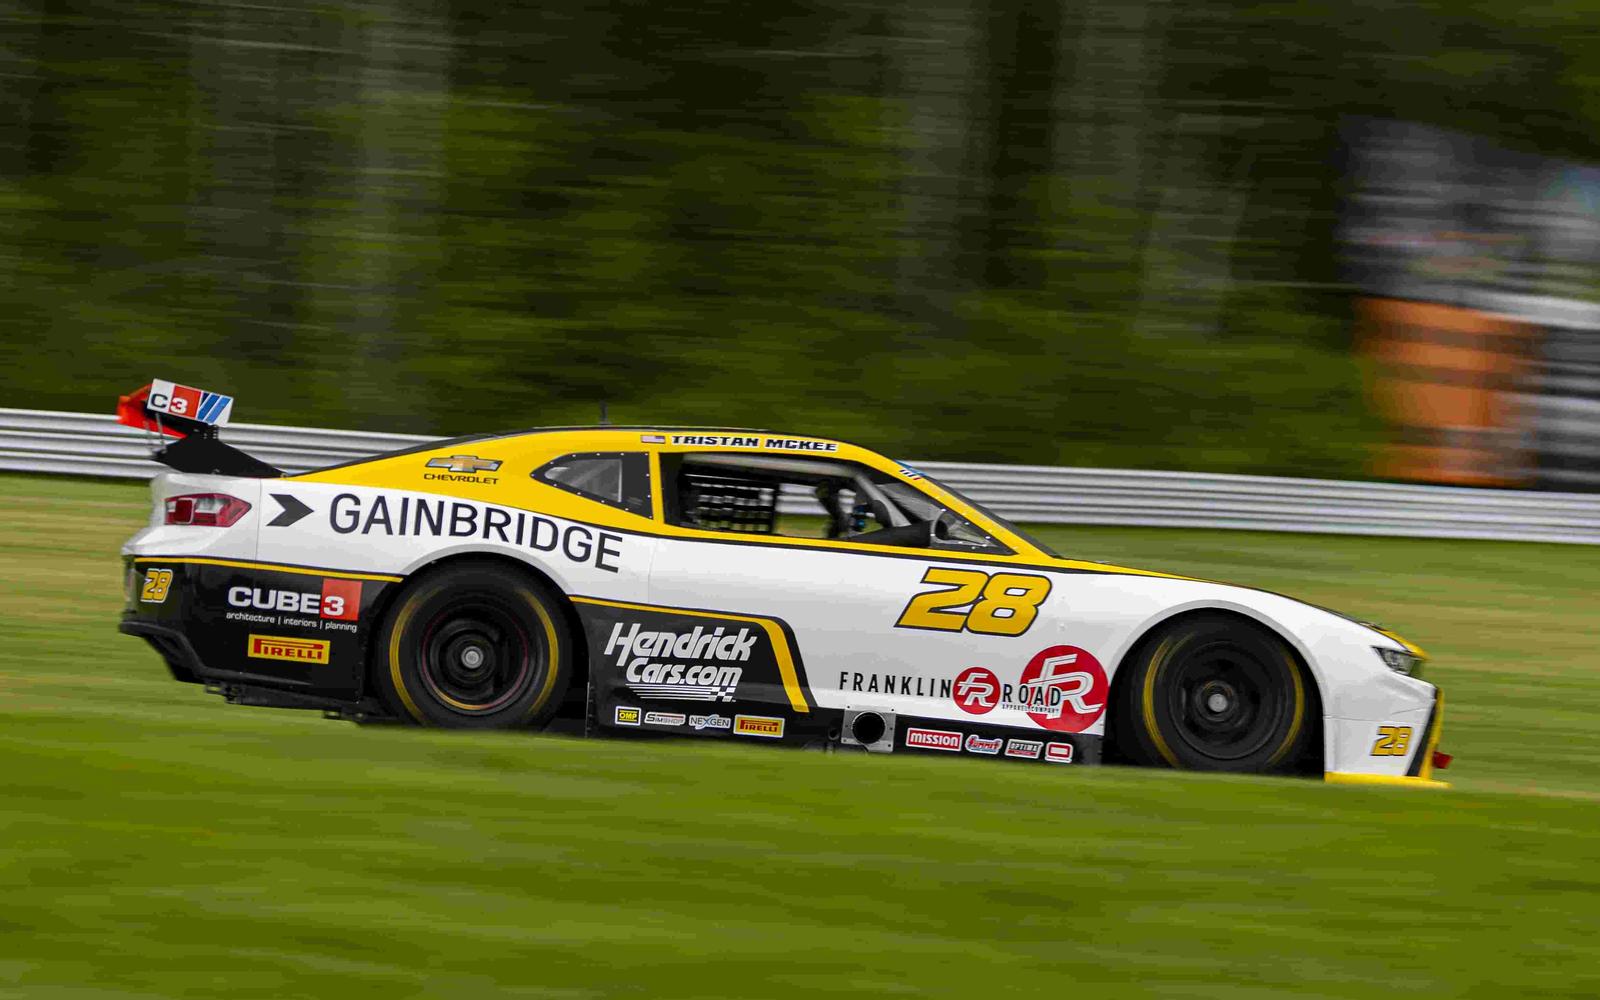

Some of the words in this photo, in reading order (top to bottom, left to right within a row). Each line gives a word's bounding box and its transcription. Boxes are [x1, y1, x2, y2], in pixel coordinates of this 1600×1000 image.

[671, 435, 759, 447] TRISTAN
[764, 438, 838, 451] MCKEE
[423, 473, 499, 485] CHEVROLET
[329, 492, 623, 574] GAINBRIDGE
[140, 568, 174, 603] 28
[895, 566, 1053, 637] 28
[226, 612, 275, 624] architecture
[283, 616, 317, 628] interiors
[325, 621, 358, 633] planning
[253, 638, 324, 660] PIRELLI
[604, 622, 758, 666] Hendrick
[626, 657, 743, 686] Cars.com
[839, 671, 952, 699] FRANKLIN
[1003, 683, 1062, 707] ROAD
[619, 711, 638, 721] OMP
[690, 715, 730, 728] NEXGEN
[740, 719, 780, 733] PIRELLI
[1009, 741, 1040, 752] OPTIMA
[1369, 726, 1413, 756] 28
